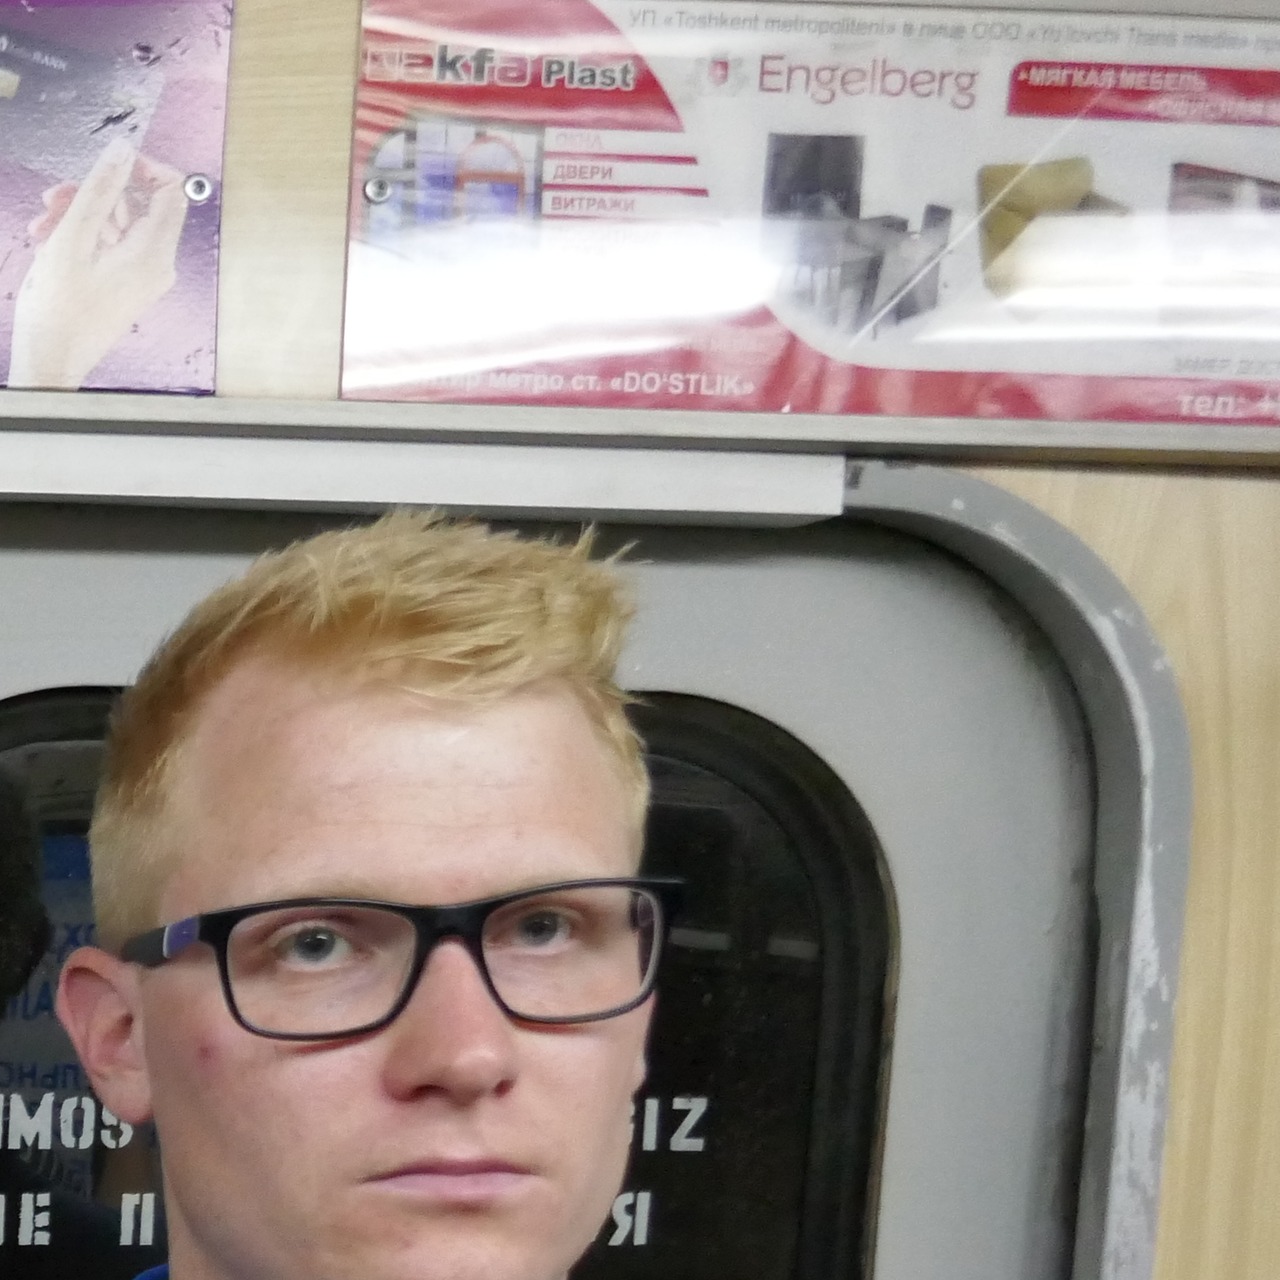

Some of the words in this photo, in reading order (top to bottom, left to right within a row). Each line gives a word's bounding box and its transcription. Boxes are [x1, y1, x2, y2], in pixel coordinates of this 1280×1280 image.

[543, 57, 638, 91] Plast
[758, 54, 981, 111] Engelberg
[552, 163, 613, 184] ДВЕРИ
[550, 194, 636, 213] ВИТРАЖИ
